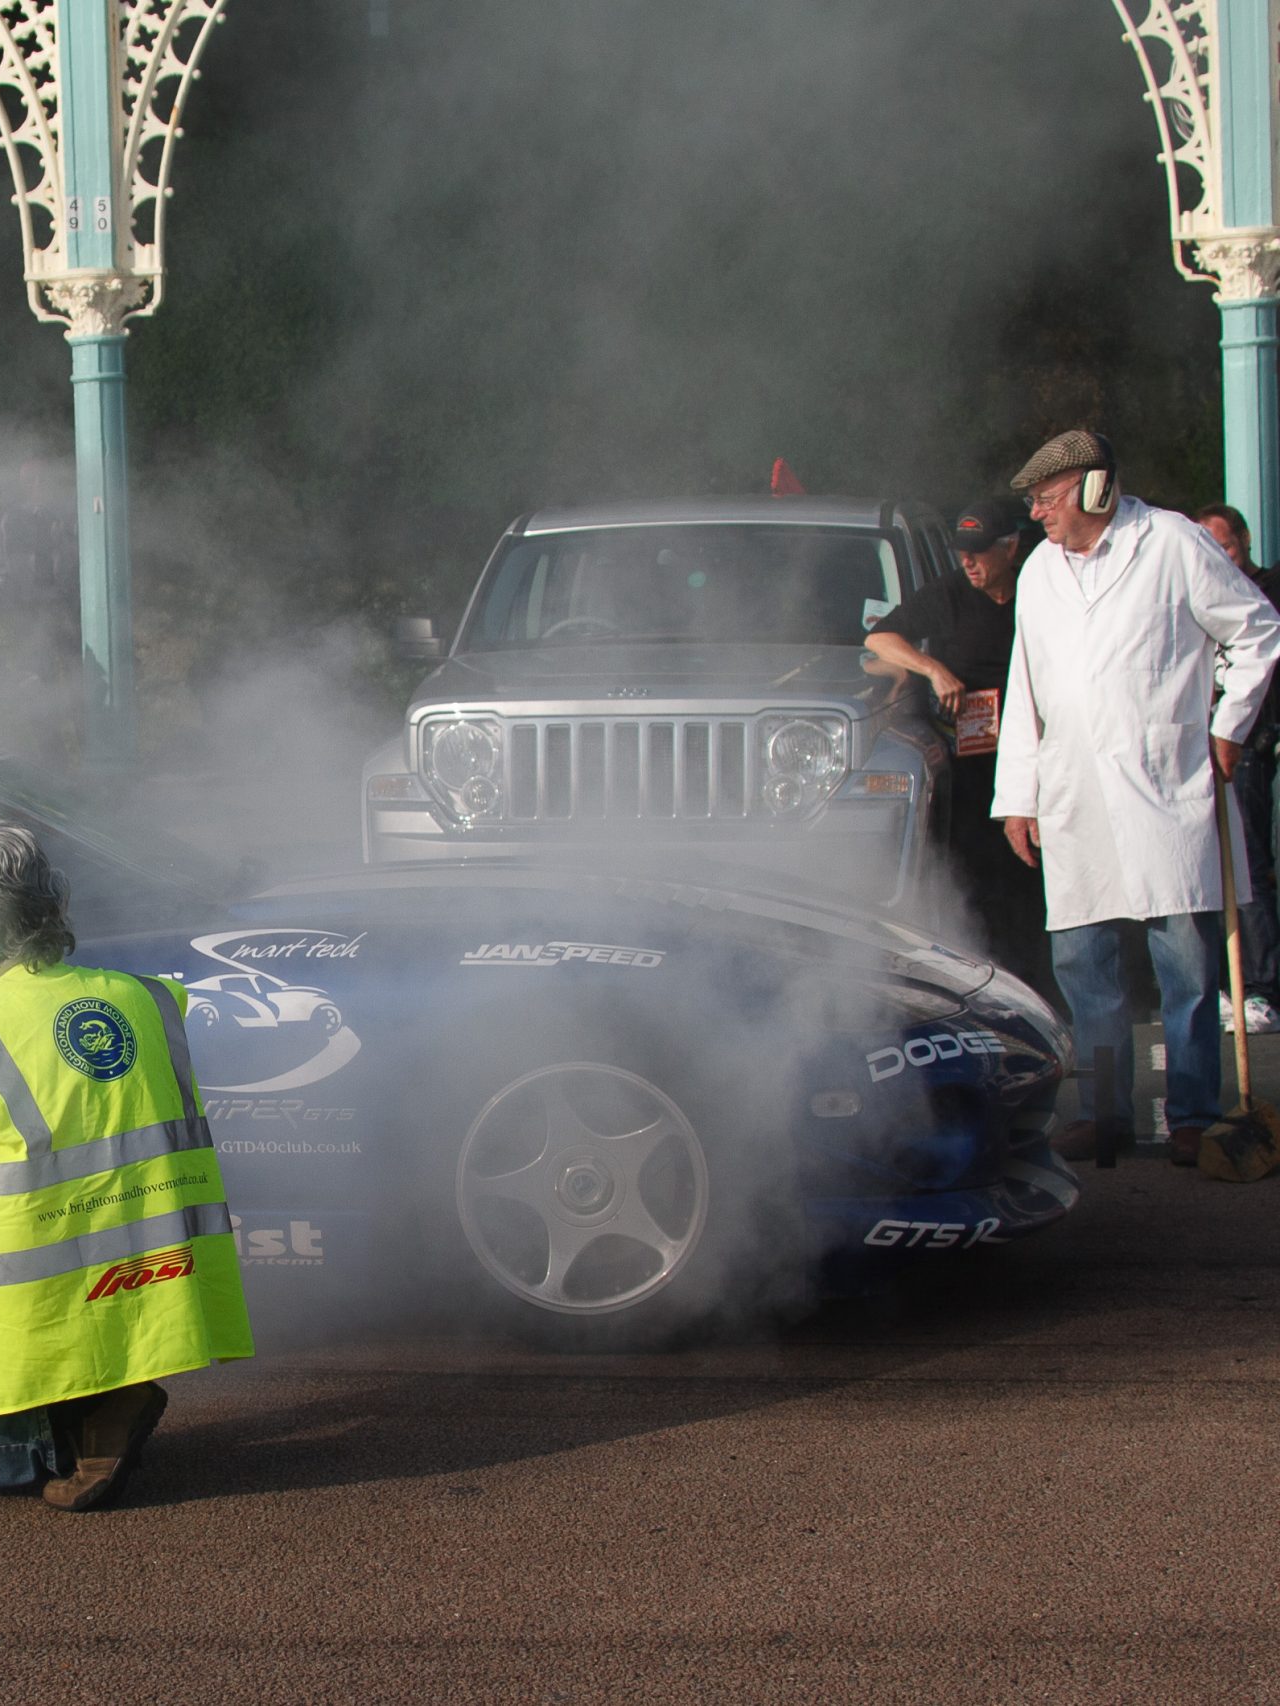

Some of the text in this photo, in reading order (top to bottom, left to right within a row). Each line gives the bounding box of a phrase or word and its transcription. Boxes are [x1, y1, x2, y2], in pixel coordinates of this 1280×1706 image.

[306, 932, 368, 959] tech
[460, 941, 666, 968] JANSPEED
[57, 1001, 134, 1076] BRIGHTON AND HOVE MOTOR CLUB
[866, 1031, 1007, 1083] DODGE
[303, 1107, 357, 1120] GTS
[864, 1217, 1013, 1249] GTS R
